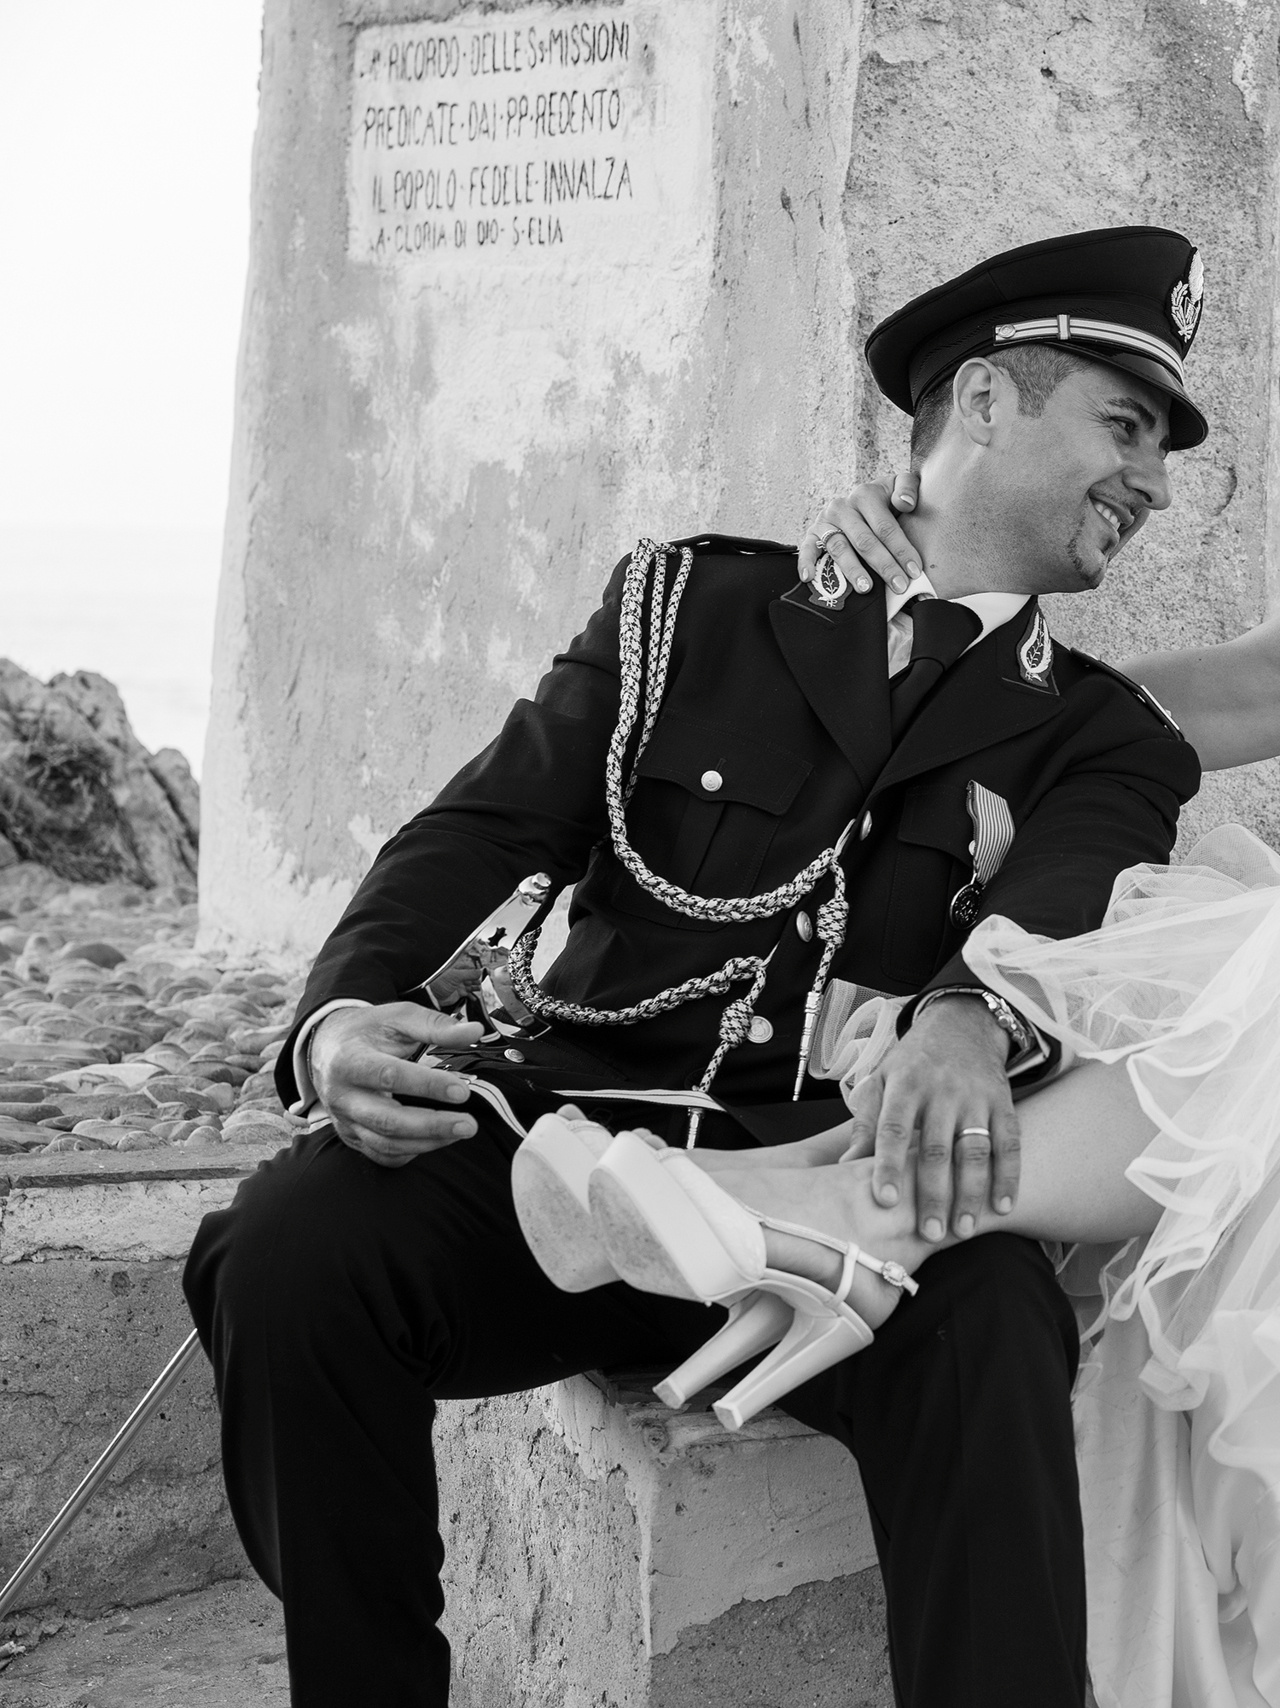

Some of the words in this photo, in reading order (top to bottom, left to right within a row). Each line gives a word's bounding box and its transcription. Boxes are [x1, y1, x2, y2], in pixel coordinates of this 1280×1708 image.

[388, 36, 460, 82] RICORDO
[471, 30, 522, 76] DELLE
[549, 20, 629, 67] MISSIONI
[364, 102, 459, 149] PREDICATE
[469, 100, 497, 141] DAI
[535, 88, 621, 140] REDENTO
[372, 174, 387, 213] IL
[394, 169, 458, 212] POPOLO
[470, 162, 535, 207] FEDELE
[544, 157, 633, 205] INNALZA
